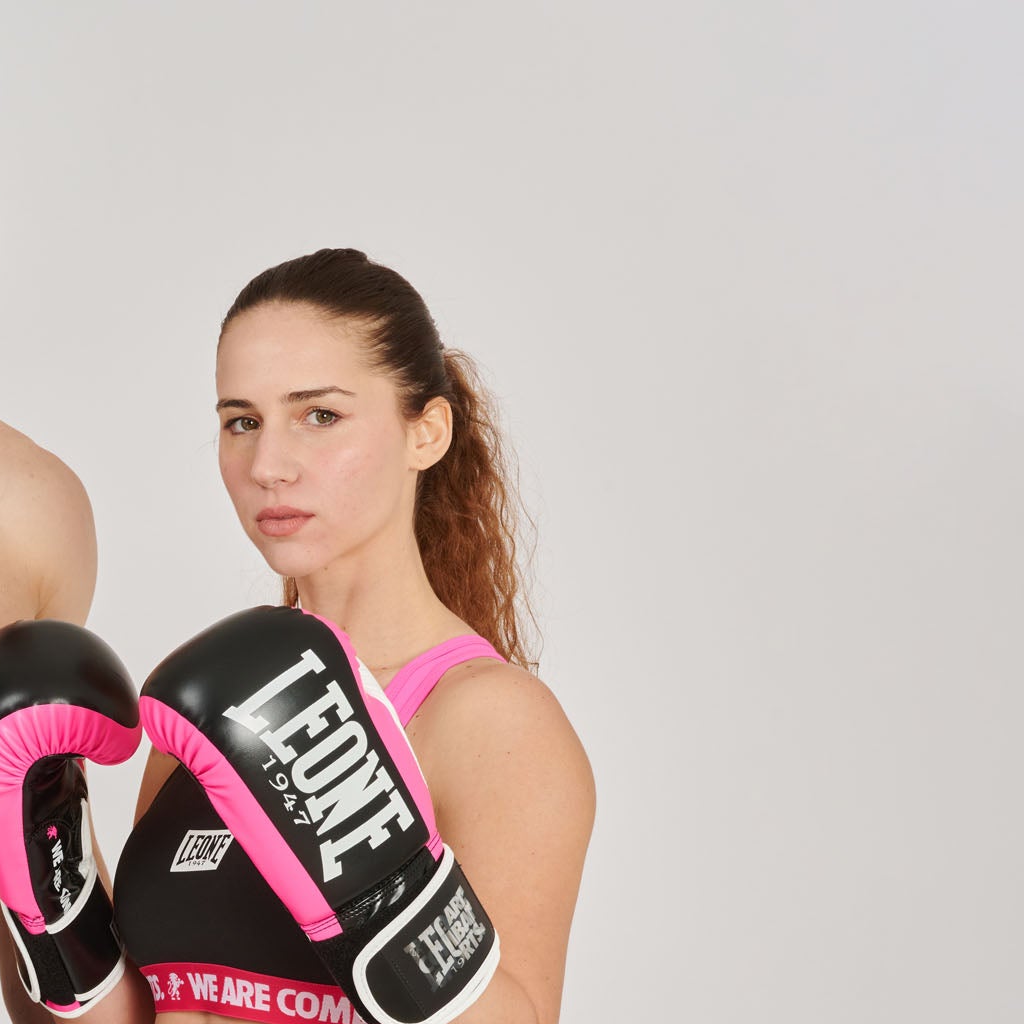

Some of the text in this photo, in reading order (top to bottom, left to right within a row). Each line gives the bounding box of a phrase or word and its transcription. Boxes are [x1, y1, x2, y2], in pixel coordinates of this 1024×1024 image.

[222, 648, 415, 883] LEONE
[261, 755, 311, 826] 1947
[52, 839, 64, 867] WE
[176, 834, 232, 866] LEONE
[186, 972, 218, 1002] WE
[221, 976, 271, 1012] ARE
